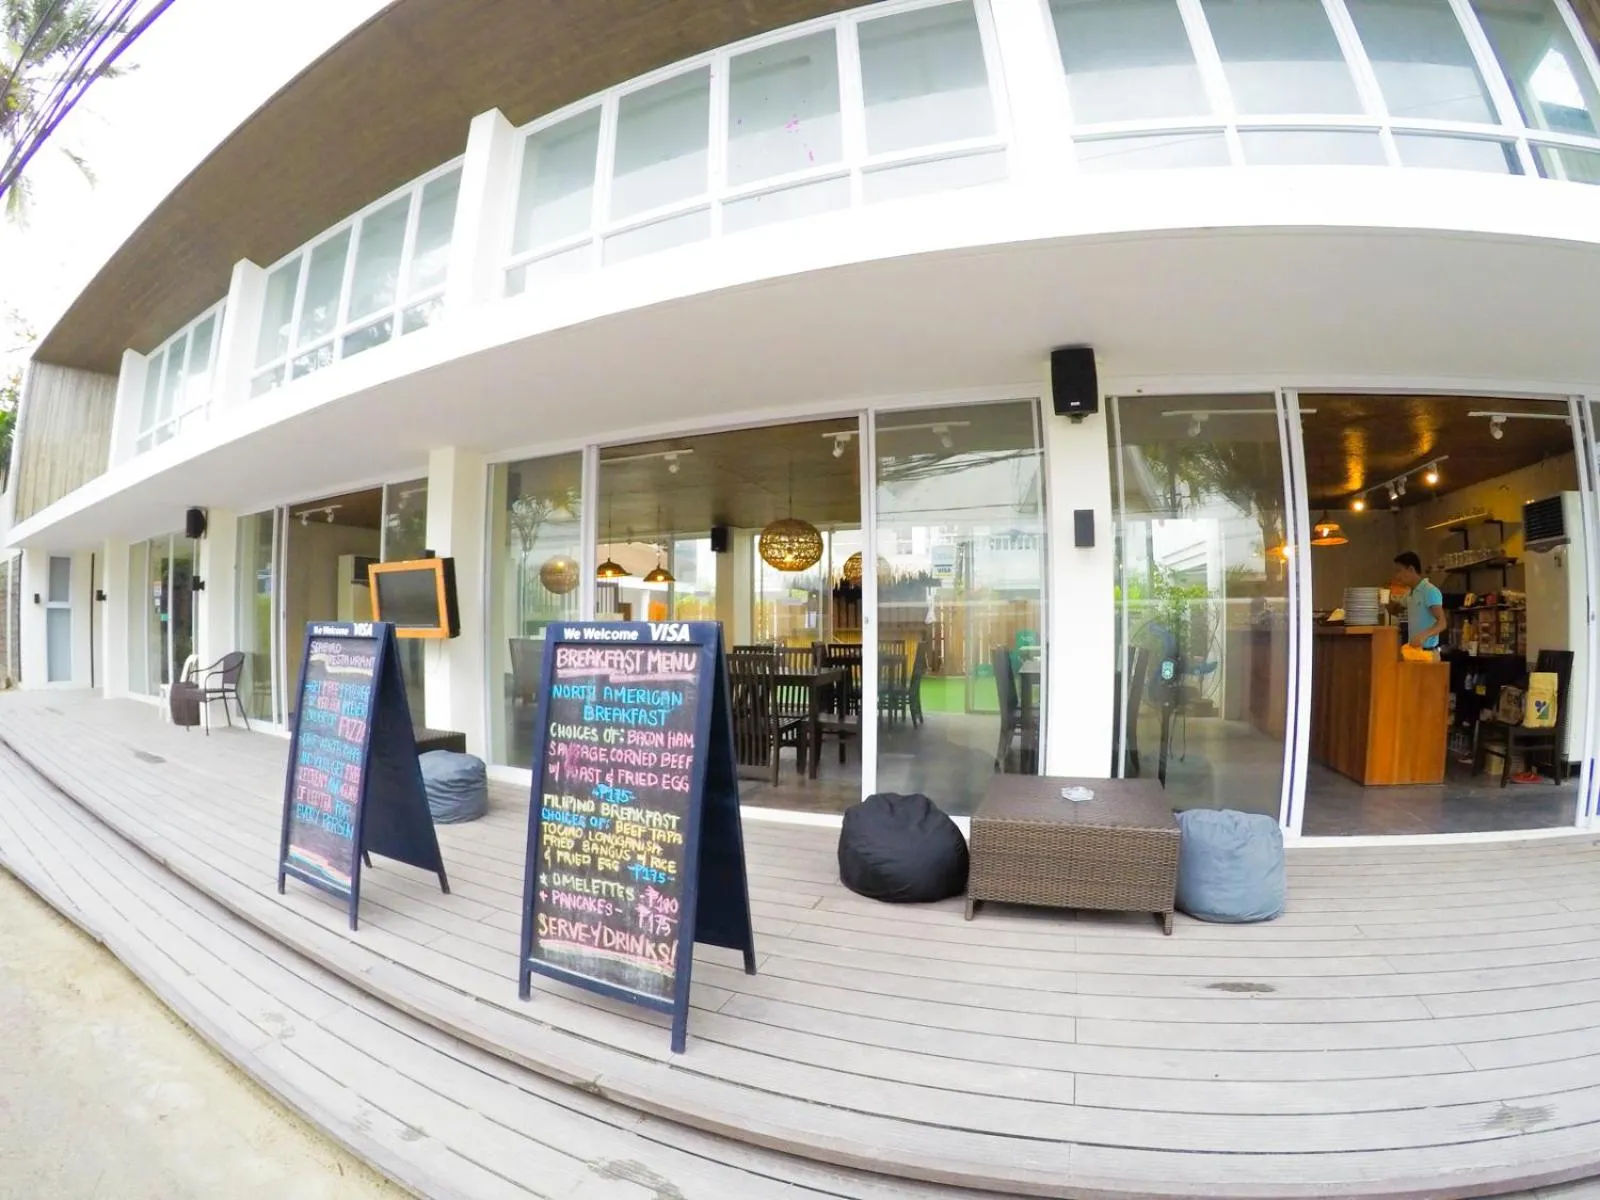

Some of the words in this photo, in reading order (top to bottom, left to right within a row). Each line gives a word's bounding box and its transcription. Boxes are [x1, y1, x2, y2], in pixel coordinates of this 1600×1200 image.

[564, 628, 581, 640] We
[584, 628, 639, 640] Welcome
[648, 623, 690, 641] VISA
[556, 648, 645, 673] BREAKFAST
[647, 648, 697, 673] MENU
[552, 684, 596, 700] NORTH
[604, 686, 683, 706] AMERICAN
[583, 704, 670, 726] BREAKFAST
[550, 722, 599, 742] CHOICES
[627, 730, 664, 747] BACON
[610, 749, 657, 768] CORNED
[660, 753, 694, 770] BEEF
[618, 769, 658, 787] FRIED
[662, 775, 689, 792] EGG
[542, 808, 586, 828] CHOICES
[615, 820, 647, 837] BEEF
[543, 793, 595, 813] FILIPINO
[601, 803, 681, 830] BREAKFAST
[582, 840, 631, 861] BANGUS
[552, 873, 635, 902] OMELETTES
[551, 890, 613, 916] PANCAKES
